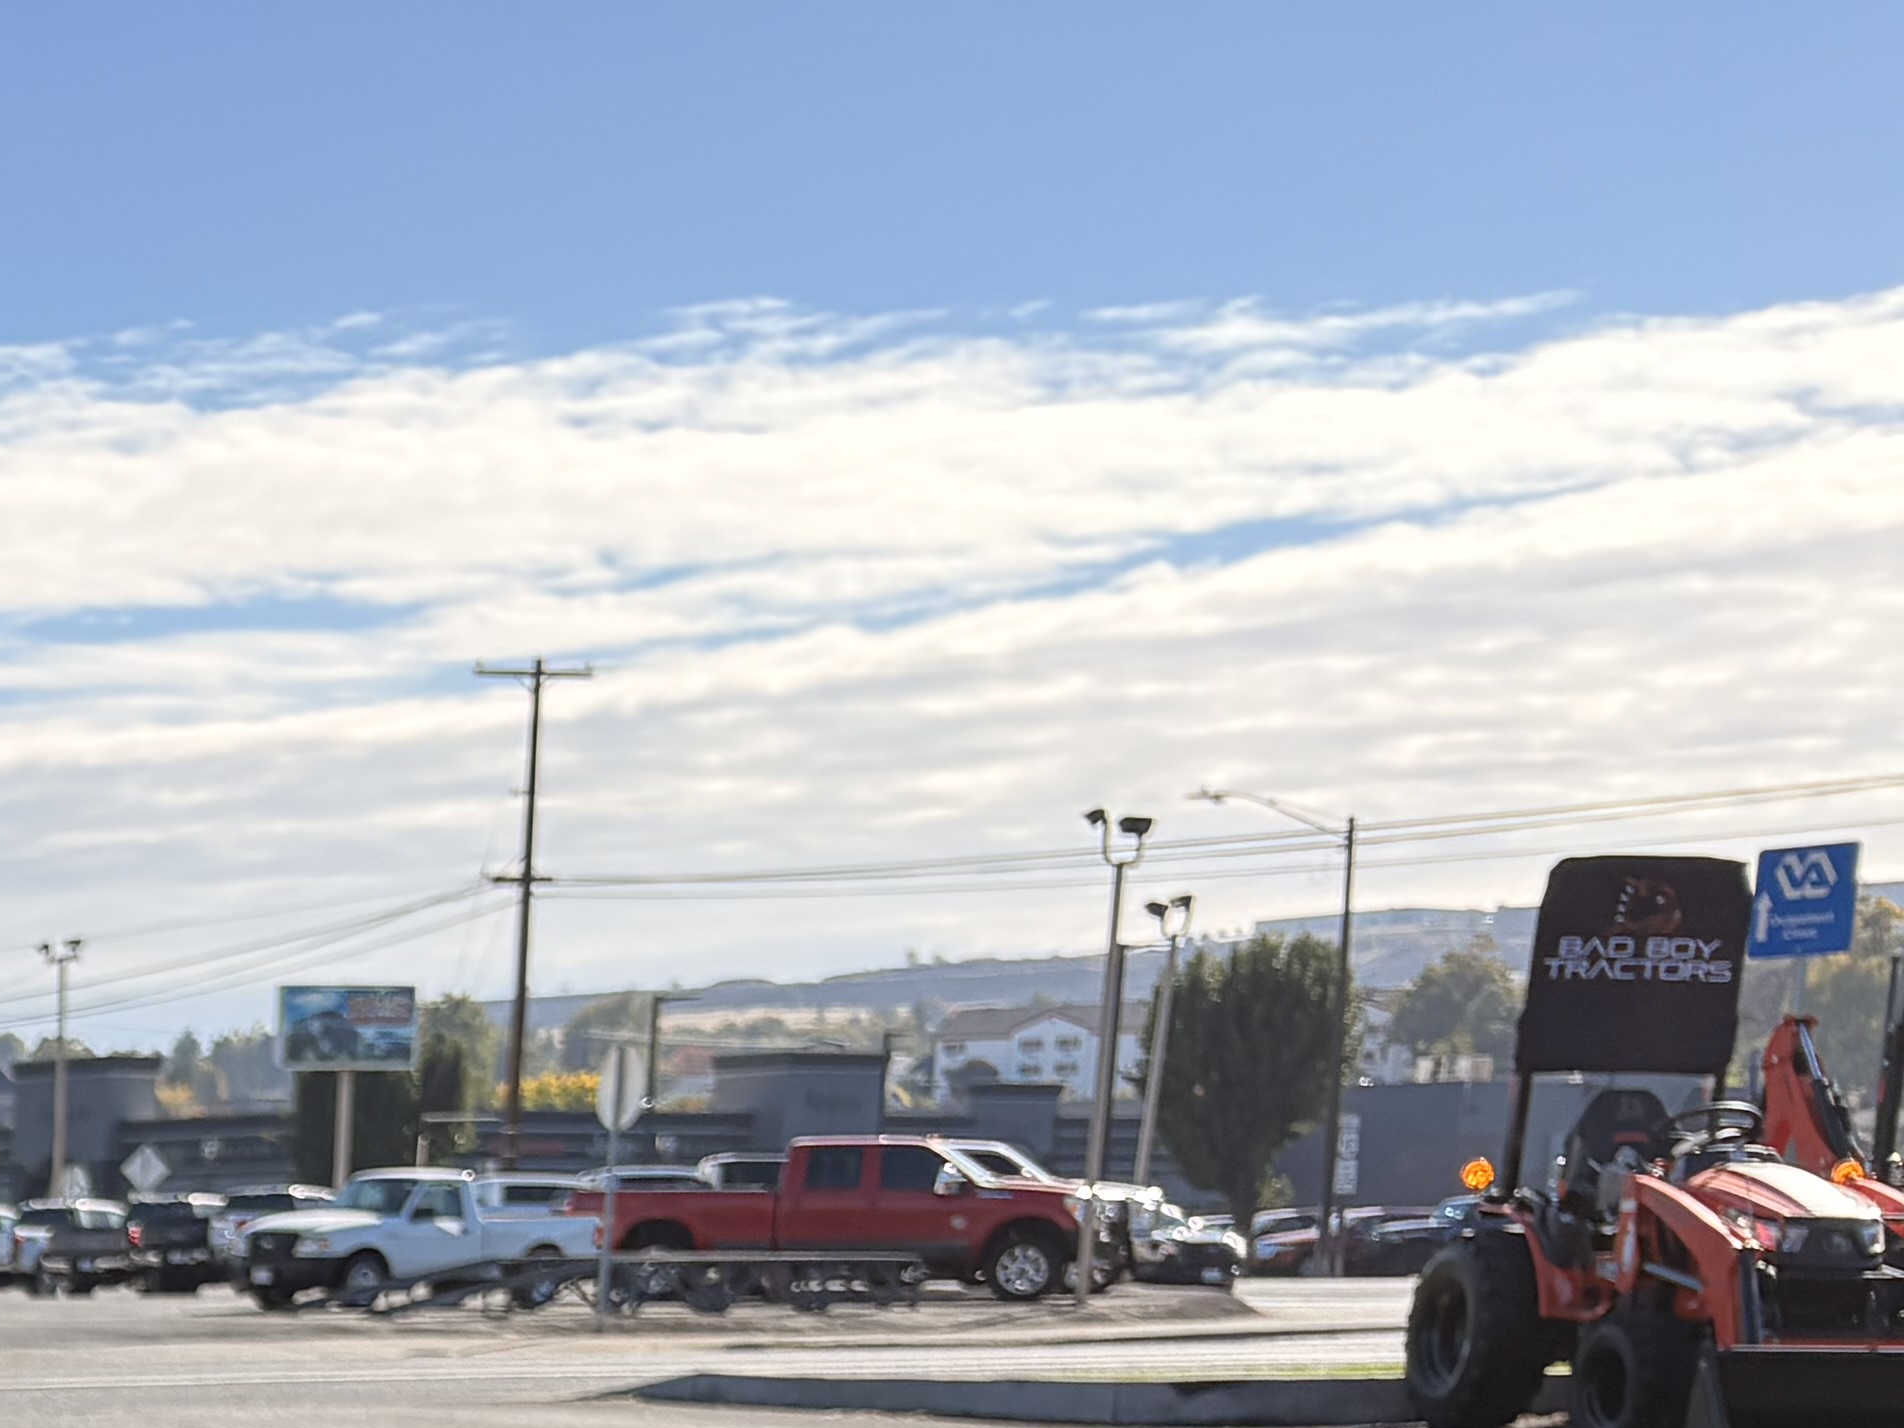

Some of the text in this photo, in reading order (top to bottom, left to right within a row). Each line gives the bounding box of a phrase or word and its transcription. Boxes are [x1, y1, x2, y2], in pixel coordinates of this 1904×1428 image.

[1558, 935, 1722, 961] BAD BOY
[1544, 957, 1733, 983] TRACTORS
